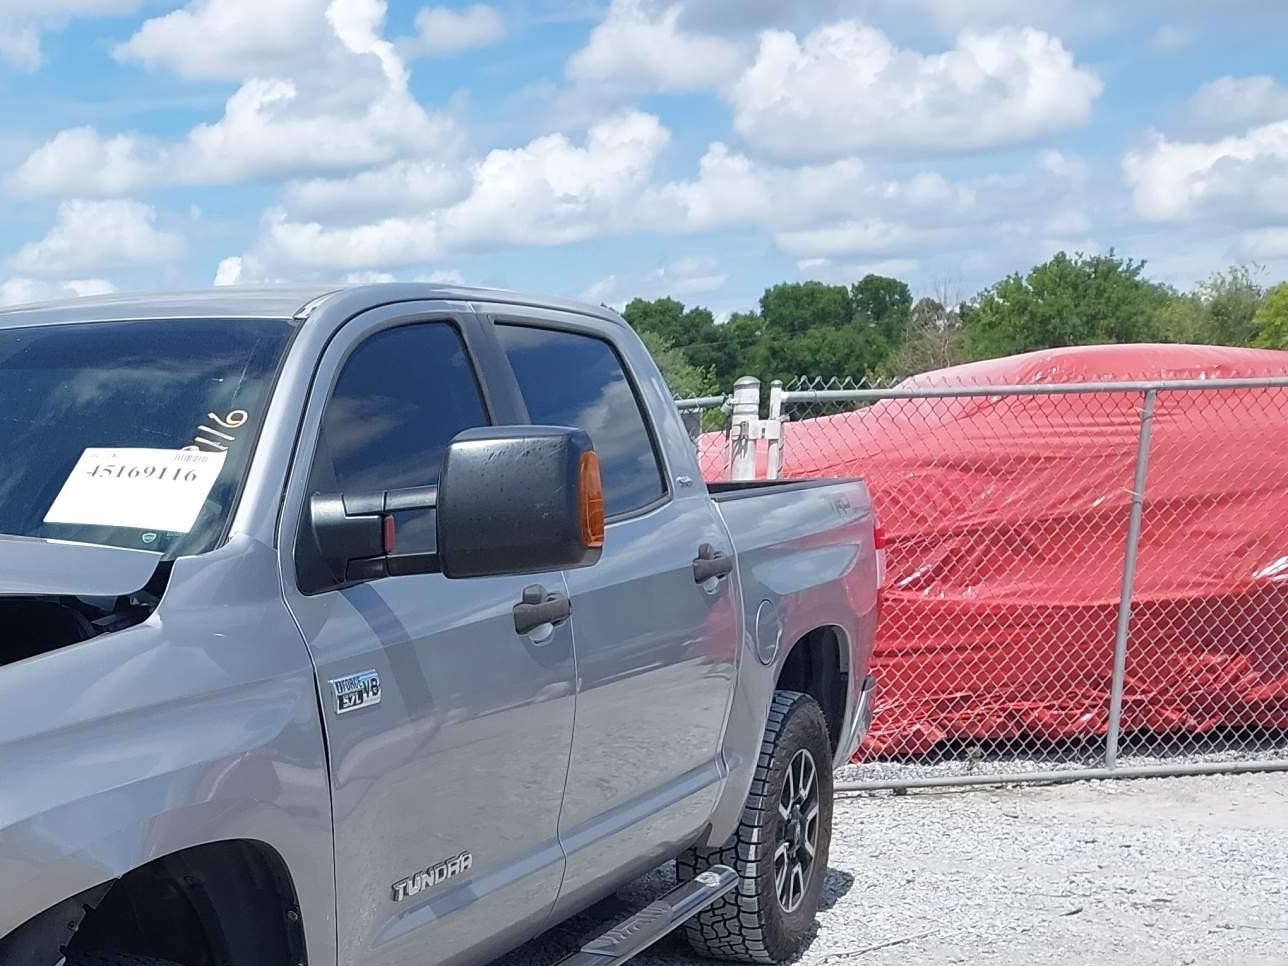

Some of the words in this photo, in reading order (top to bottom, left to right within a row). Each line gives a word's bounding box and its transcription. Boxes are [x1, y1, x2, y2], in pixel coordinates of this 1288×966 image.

[86, 464, 198, 482] 45169116
[362, 677, 379, 698] V8
[392, 850, 473, 902] TUNDRA
